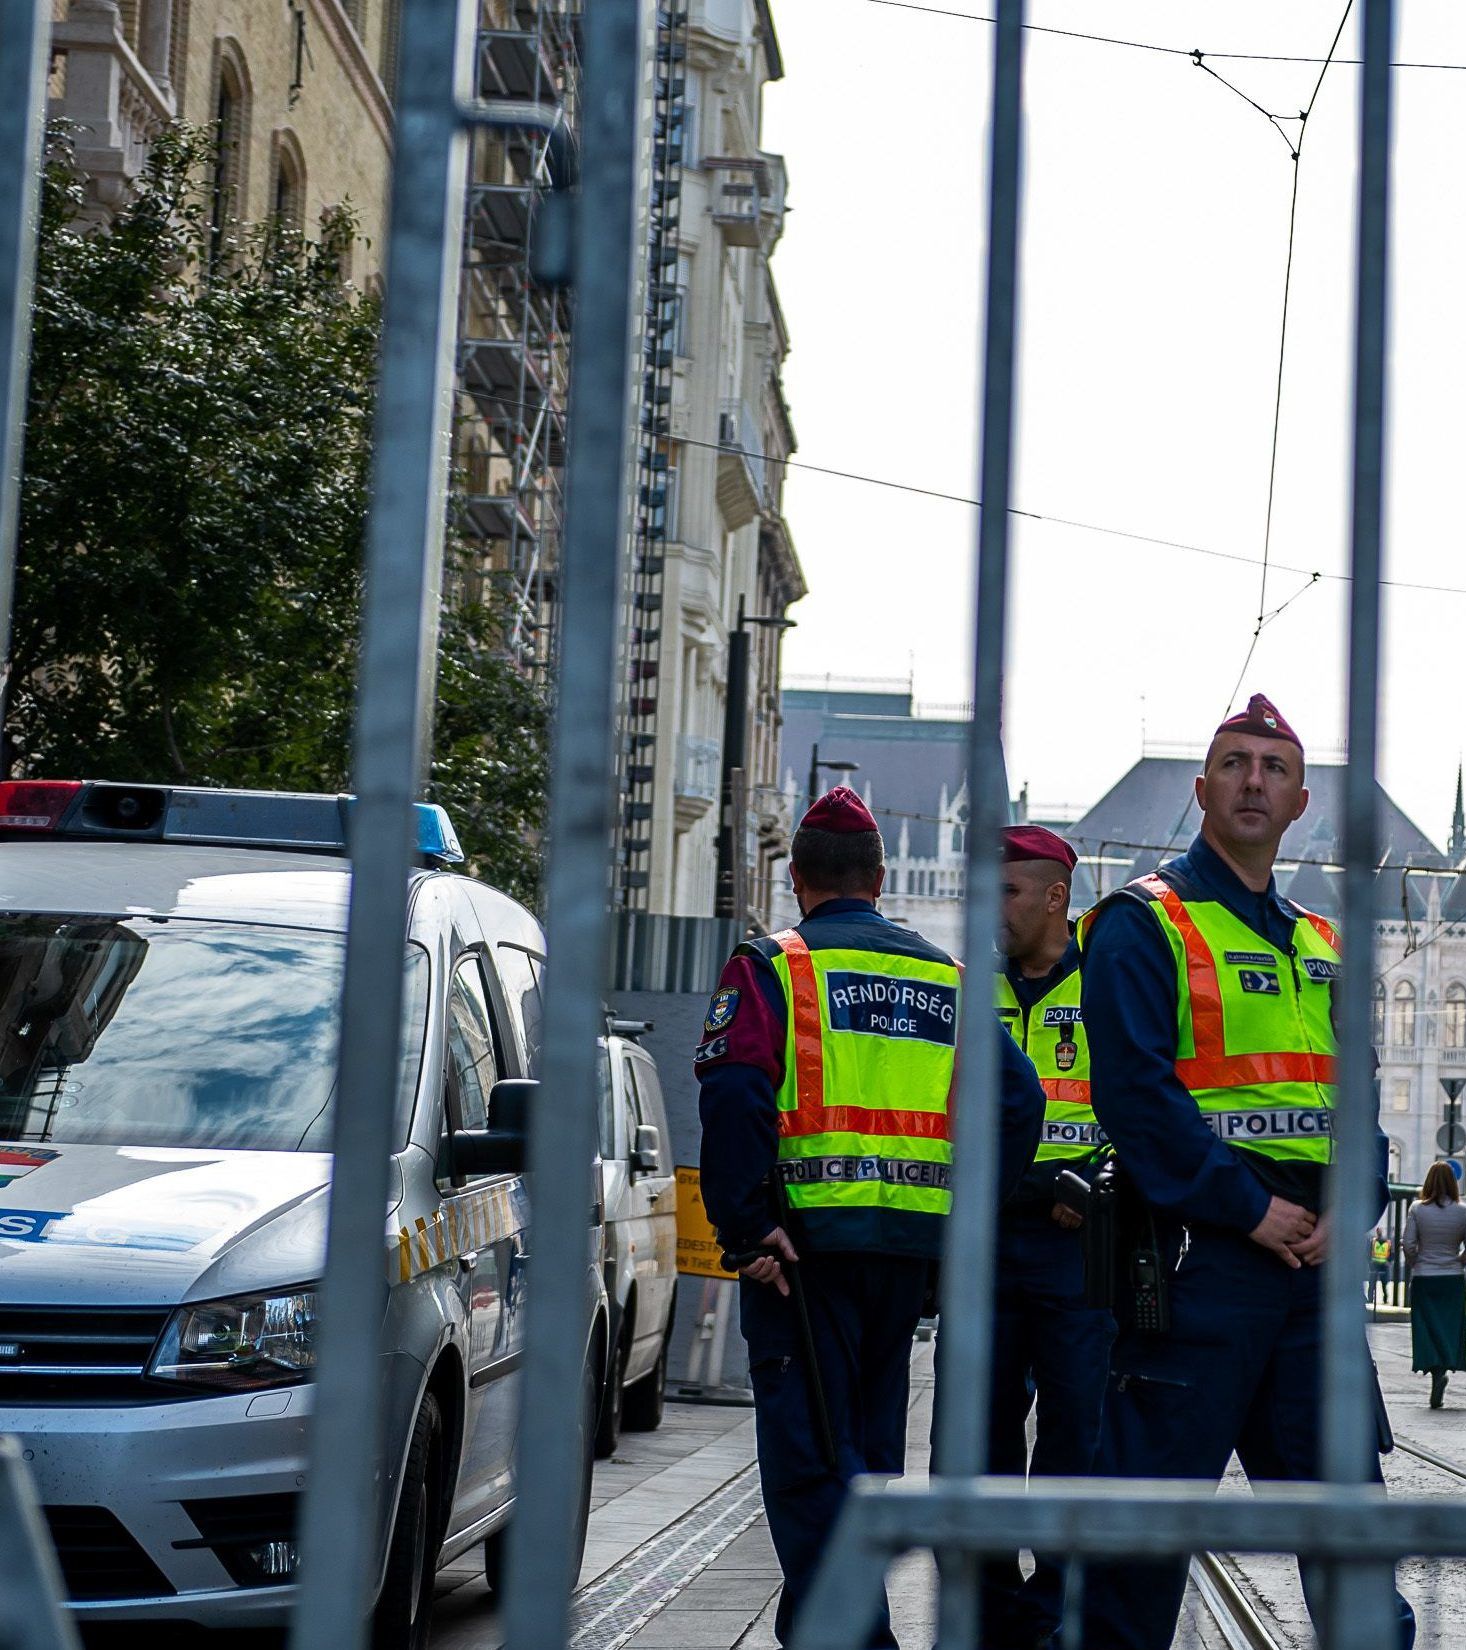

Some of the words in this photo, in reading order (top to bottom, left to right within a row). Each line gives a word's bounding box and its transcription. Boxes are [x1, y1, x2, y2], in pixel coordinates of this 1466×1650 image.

[1306, 961, 1341, 976] POLI
[831, 980, 954, 1025] RENDŐRSÉG
[870, 1014, 917, 1032] POLICE
[1227, 1111, 1330, 1136] POLICE
[780, 1160, 852, 1180] POLICE
